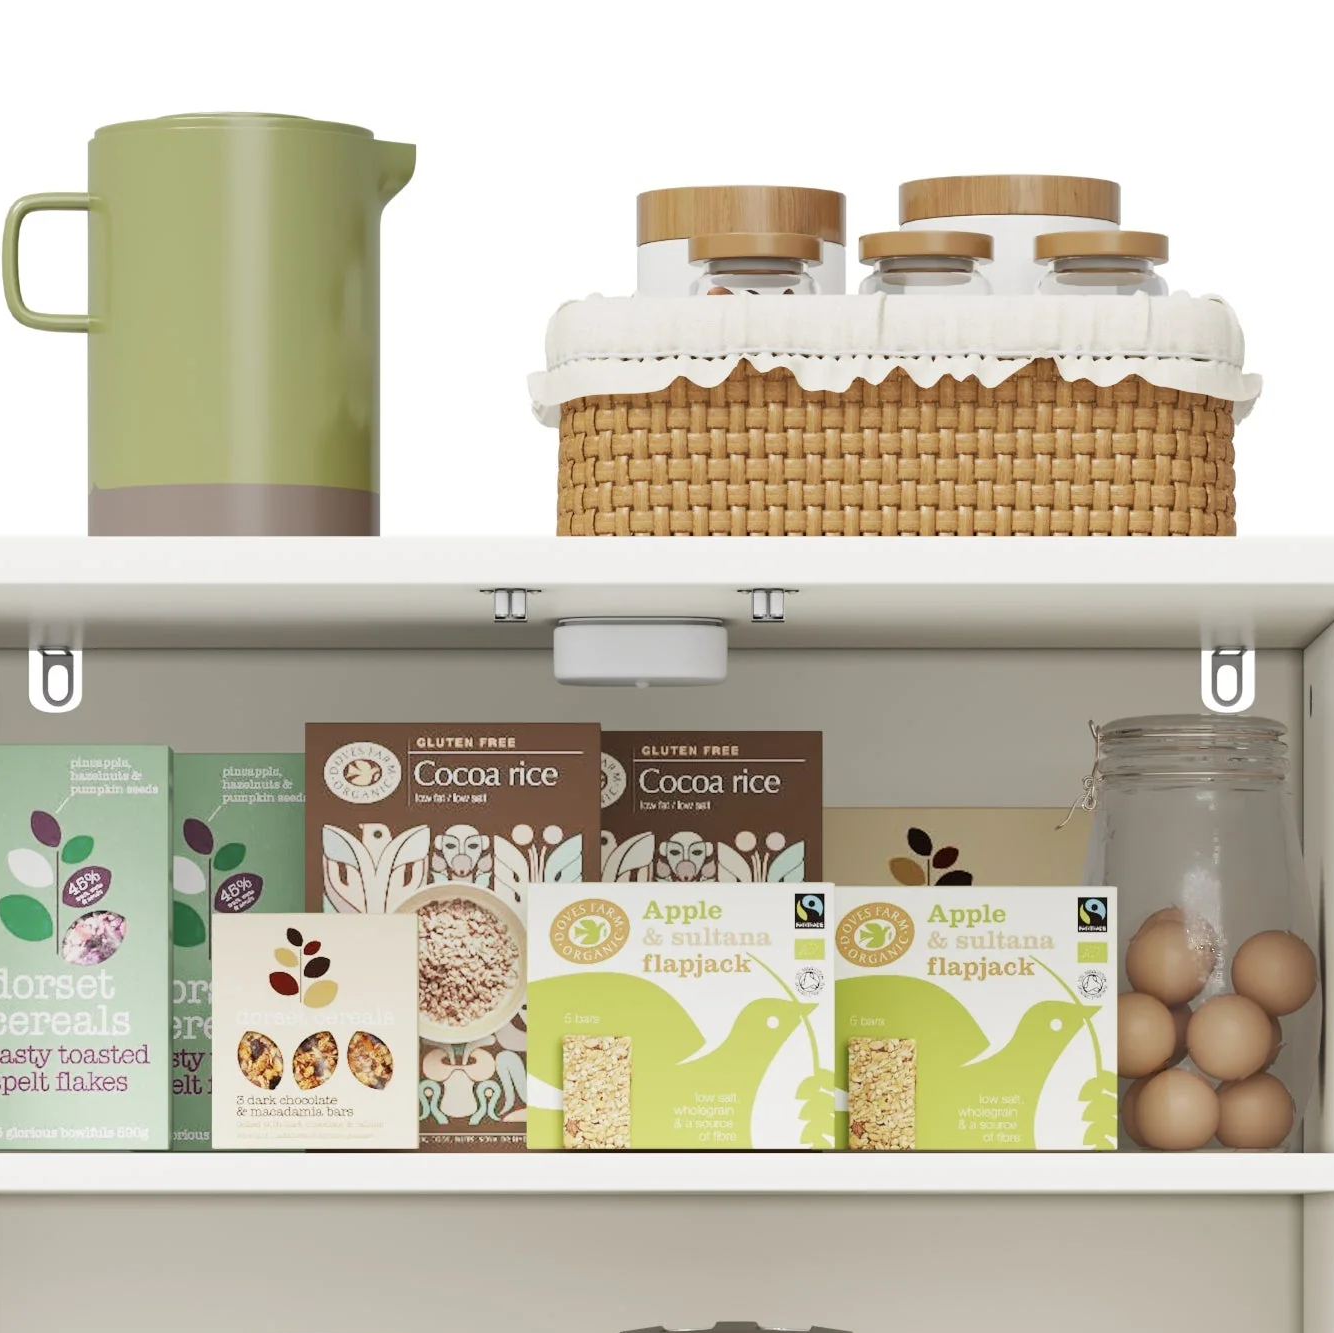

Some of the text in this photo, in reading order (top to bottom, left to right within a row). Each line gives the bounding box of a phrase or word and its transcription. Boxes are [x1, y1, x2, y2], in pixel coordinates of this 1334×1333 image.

[416, 737, 516, 749] GLUTEN FREE
[641, 745, 740, 756] GLUTEN FREE
[413, 759, 559, 788] Cocoa rice
[639, 767, 781, 795] Cocoa rice
[71, 783, 159, 797] pumpkin seeds
[642, 900, 722, 925] Apple
[927, 904, 1006, 929] Apple
[642, 928, 772, 947] & sultana
[927, 931, 1055, 950] & sultana
[642, 954, 752, 979] flapjack
[927, 957, 1035, 982] flapjack
[58, 1045, 150, 1065] toasted
[56, 1072, 129, 1092] flakes
[236, 1096, 338, 1106] 3 dark chocolate
[236, 1107, 354, 1117] & macadamia bars
